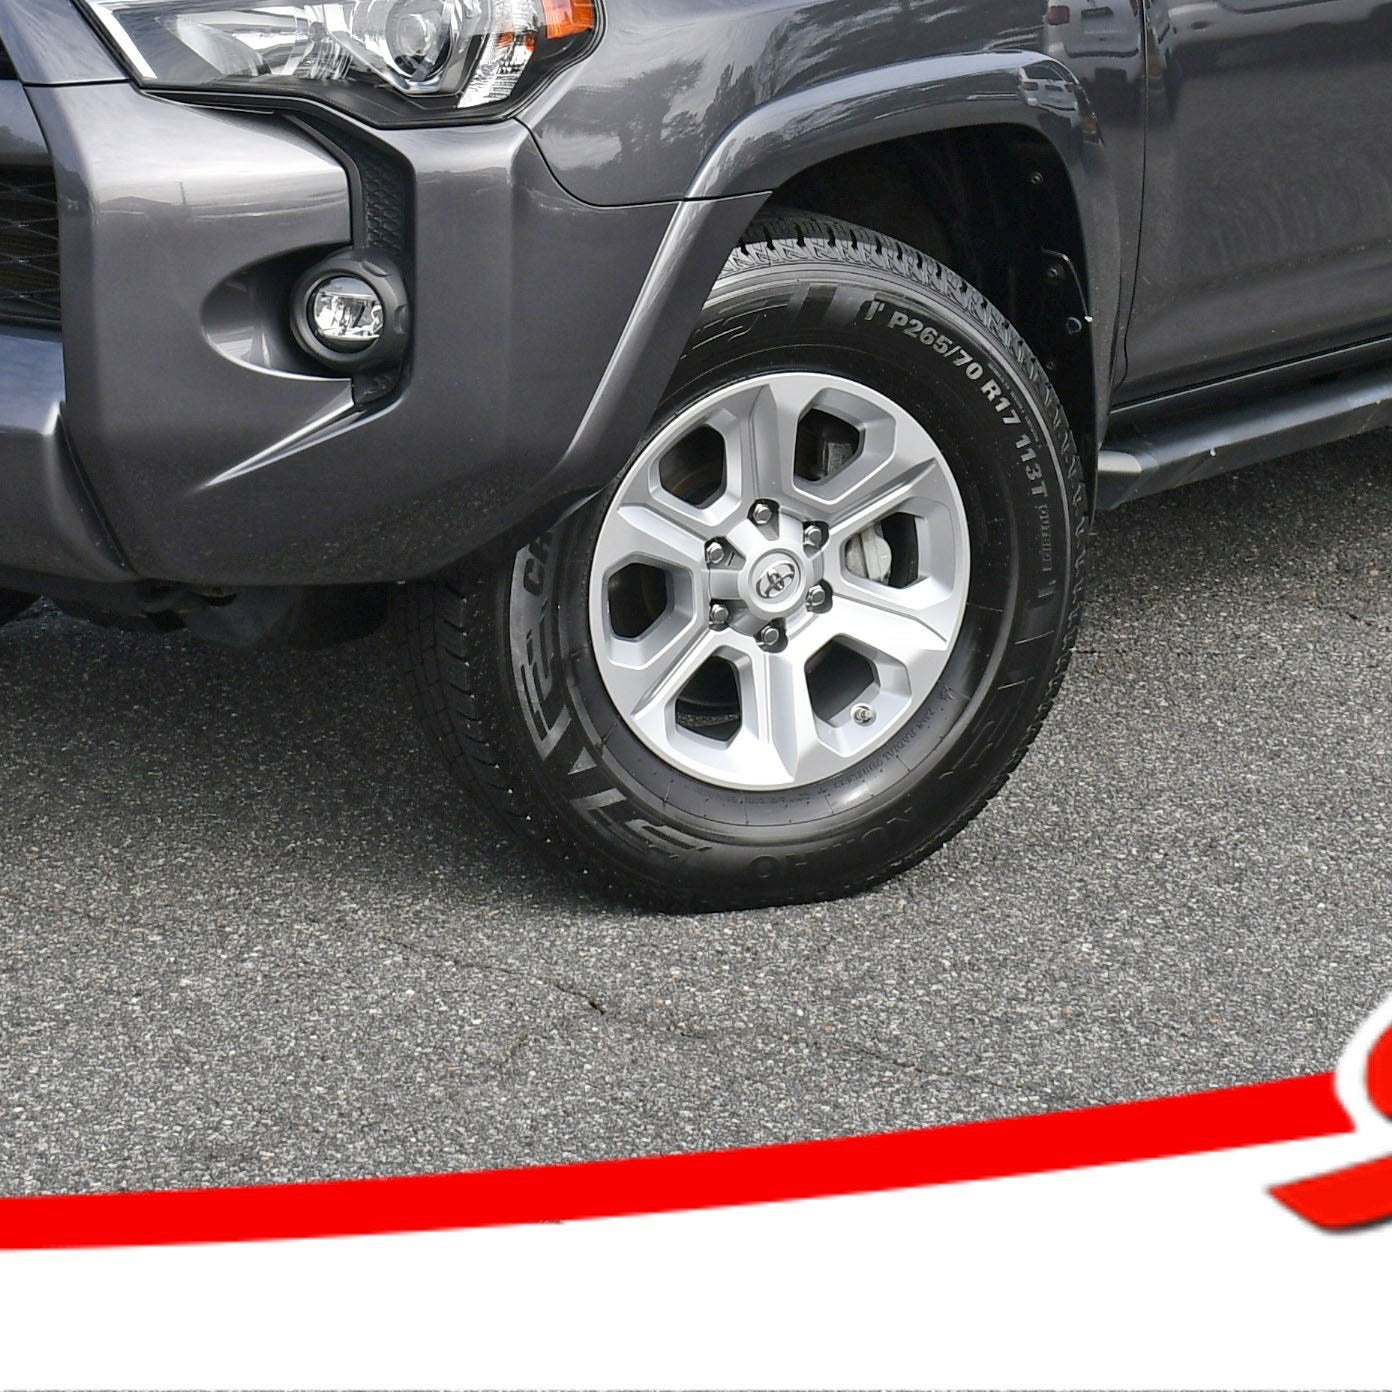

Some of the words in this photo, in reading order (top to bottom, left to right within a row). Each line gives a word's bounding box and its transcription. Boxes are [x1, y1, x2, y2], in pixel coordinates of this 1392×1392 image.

[888, 312, 983, 380] P265/70
[981, 379, 1021, 425] R17
[1015, 434, 1048, 498] 113T
